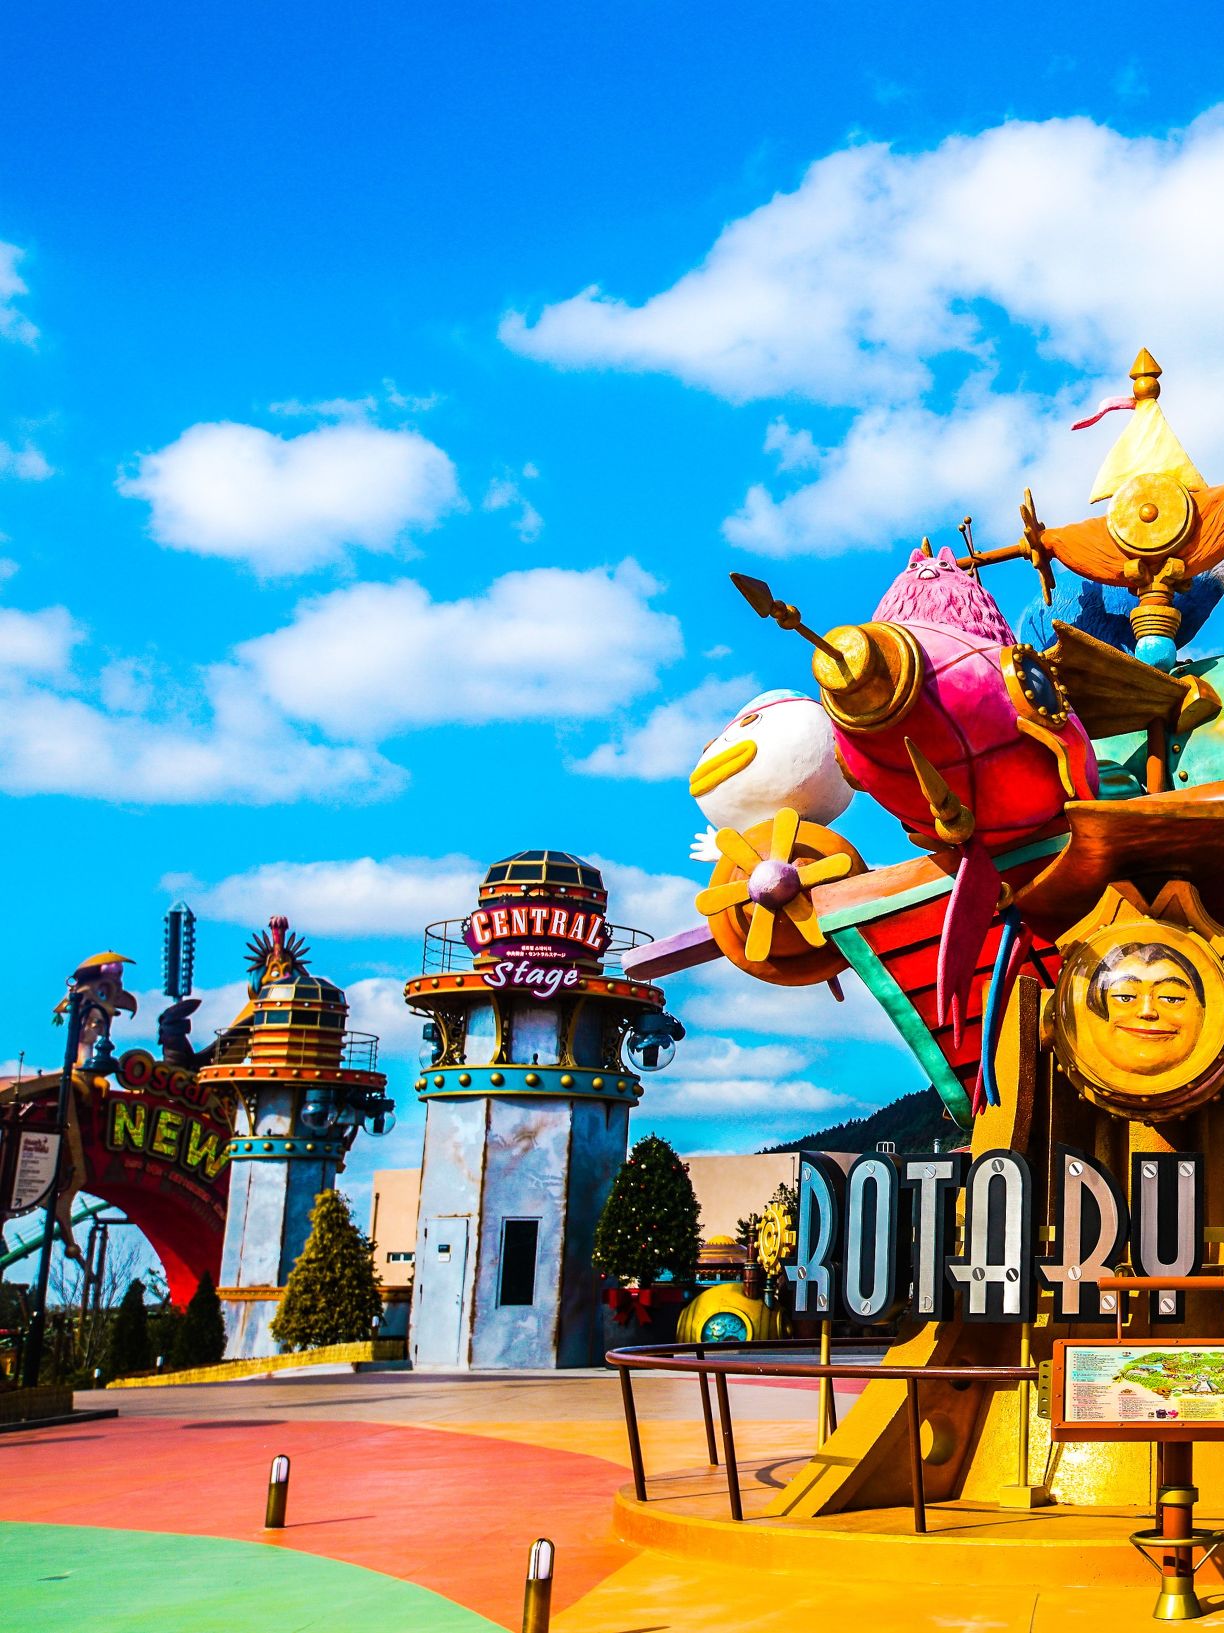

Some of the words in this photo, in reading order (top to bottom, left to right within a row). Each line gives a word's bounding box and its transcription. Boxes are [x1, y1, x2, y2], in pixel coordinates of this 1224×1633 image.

[471, 906, 605, 950] CENTRAL
[484, 960, 579, 998] Stage
[113, 1102, 231, 1178] NEW
[784, 1153, 1196, 1316] ROTARY
